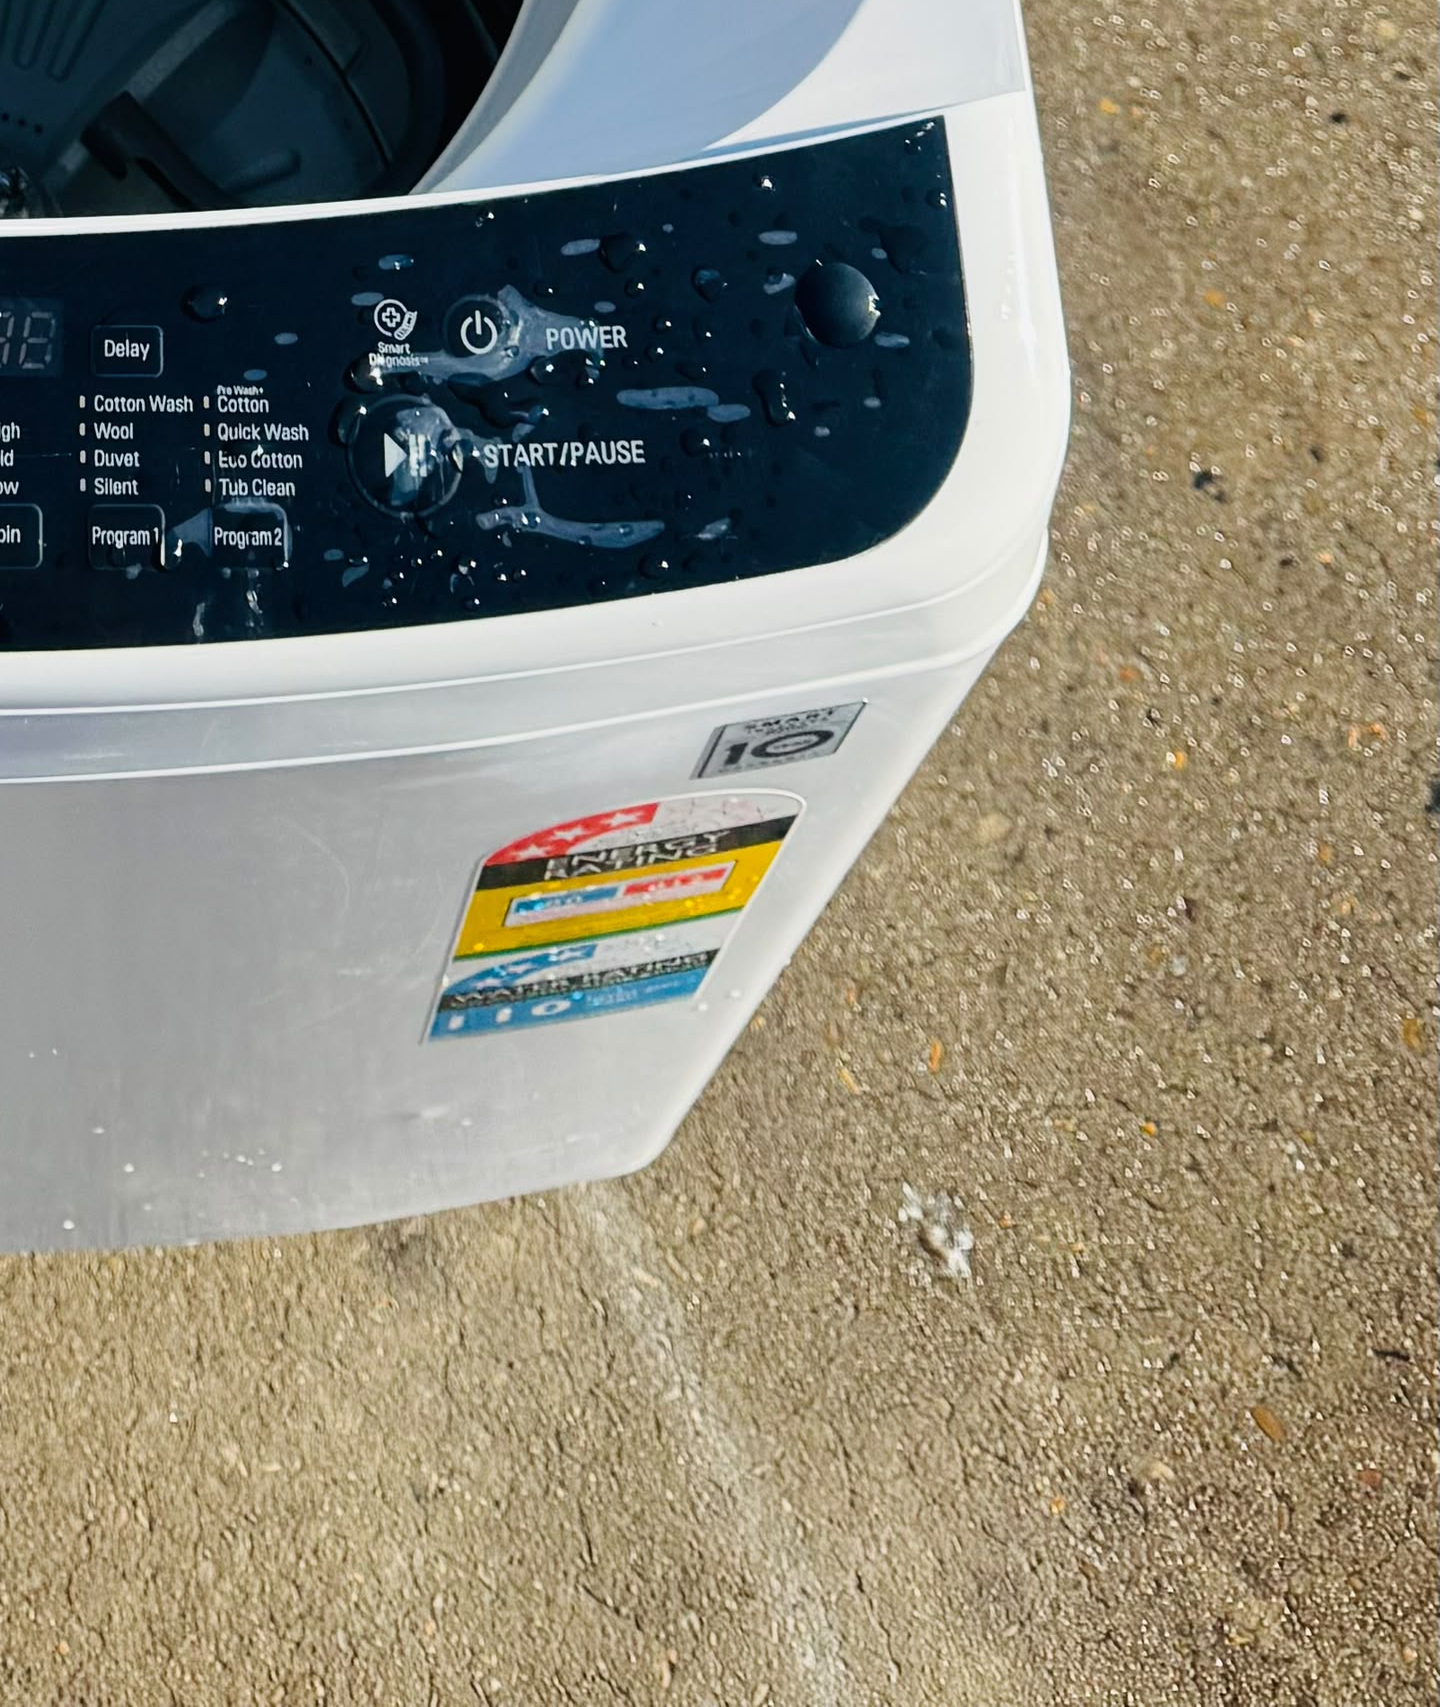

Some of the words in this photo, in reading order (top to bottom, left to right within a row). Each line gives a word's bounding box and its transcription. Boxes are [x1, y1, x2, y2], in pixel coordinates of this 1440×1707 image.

[546, 325, 628, 351] POWER
[104, 338, 150, 361] Delay
[378, 342, 411, 354] Smart
[94, 394, 146, 413] Cotton
[149, 394, 194, 413] Wash
[217, 395, 269, 413] Cotton
[94, 422, 134, 440] Wool
[217, 423, 261, 441] Quick
[264, 423, 309, 441] Wash
[94, 450, 140, 468] Duvet
[251, 452, 303, 469] Cotton
[483, 440, 646, 468] START/PAUSE
[94, 478, 139, 496] Silent
[219, 479, 249, 496] Tub
[252, 479, 296, 497] Clean
[92, 526, 151, 549] Program
[153, 527, 159, 546] 1
[214, 526, 272, 550] Program
[274, 527, 282, 546] 2
[723, 730, 835, 766] 10
